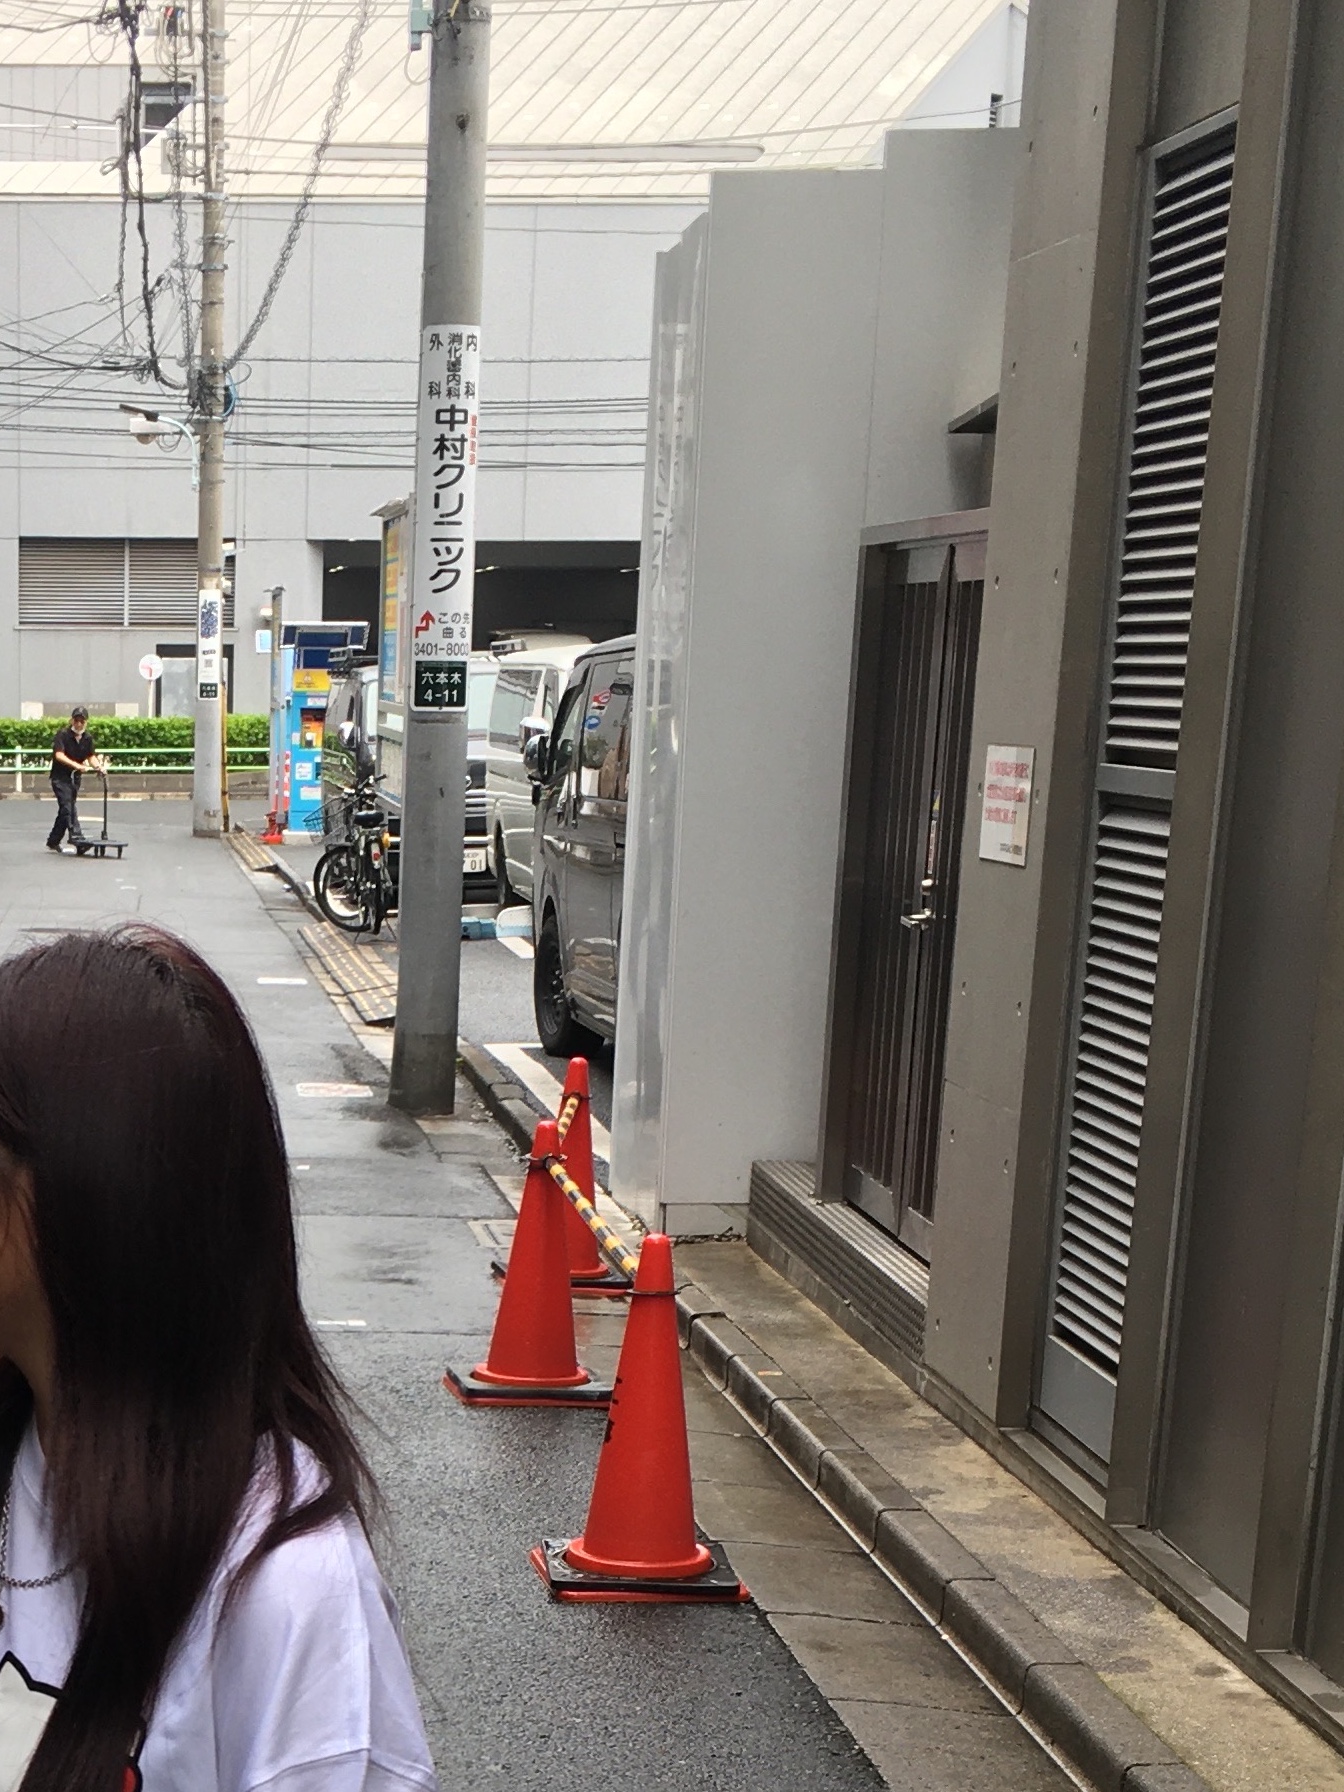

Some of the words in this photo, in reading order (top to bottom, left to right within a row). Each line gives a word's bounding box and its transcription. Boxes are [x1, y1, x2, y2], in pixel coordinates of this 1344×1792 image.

[428, 333, 444, 399] 外科
[429, 404, 468, 594] 中村クリニック
[438, 612, 470, 625] この先
[442, 626, 467, 639] 曲る
[421, 671, 462, 685] 六本木
[423, 689, 458, 702] 4-11
